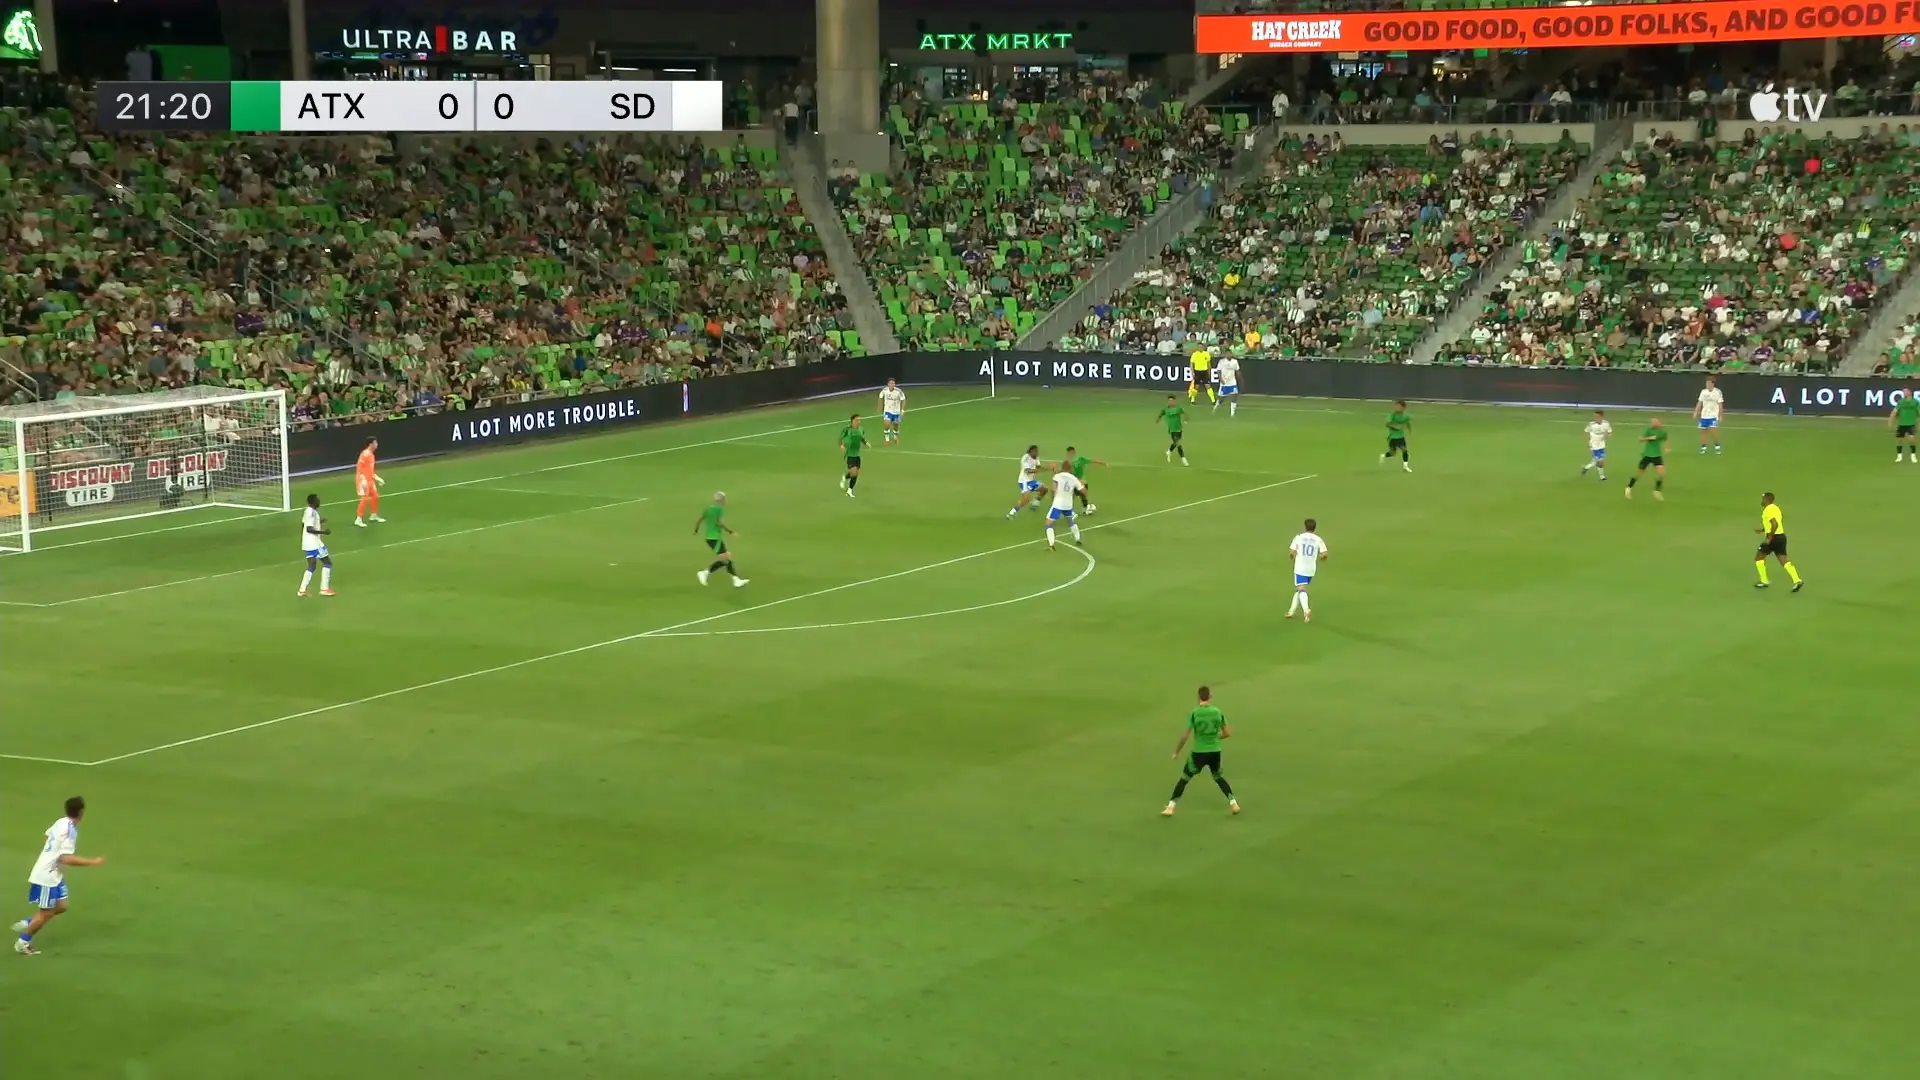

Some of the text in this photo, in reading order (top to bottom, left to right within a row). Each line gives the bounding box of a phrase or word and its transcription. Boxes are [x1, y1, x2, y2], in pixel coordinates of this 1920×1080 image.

[1251, 20, 1342, 40] HAT CREEK
[1364, 20, 1440, 42] GOOD
[1446, 18, 1527, 44] FOOD,
[1533, 15, 1612, 38] GOOD
[1621, 11, 1718, 38] FOLKS,
[1725, 8, 1788, 33] AND
[1796, 3, 1887, 29] GOOD
[343, 29, 516, 51] ULTRA BAR
[920, 33, 1073, 50] ATX MRKT
[978, 360, 1219, 383] A LOT MORE TROUBE
[1771, 387, 1920, 407] A LOT MO
[452, 400, 640, 441] A LOT MORE TROUBLE.
[48, 462, 134, 492] DISCOUNT
[1064, 481, 1070, 492] 6
[72, 487, 108, 502] TIRE
[1302, 543, 1315, 557] 10
